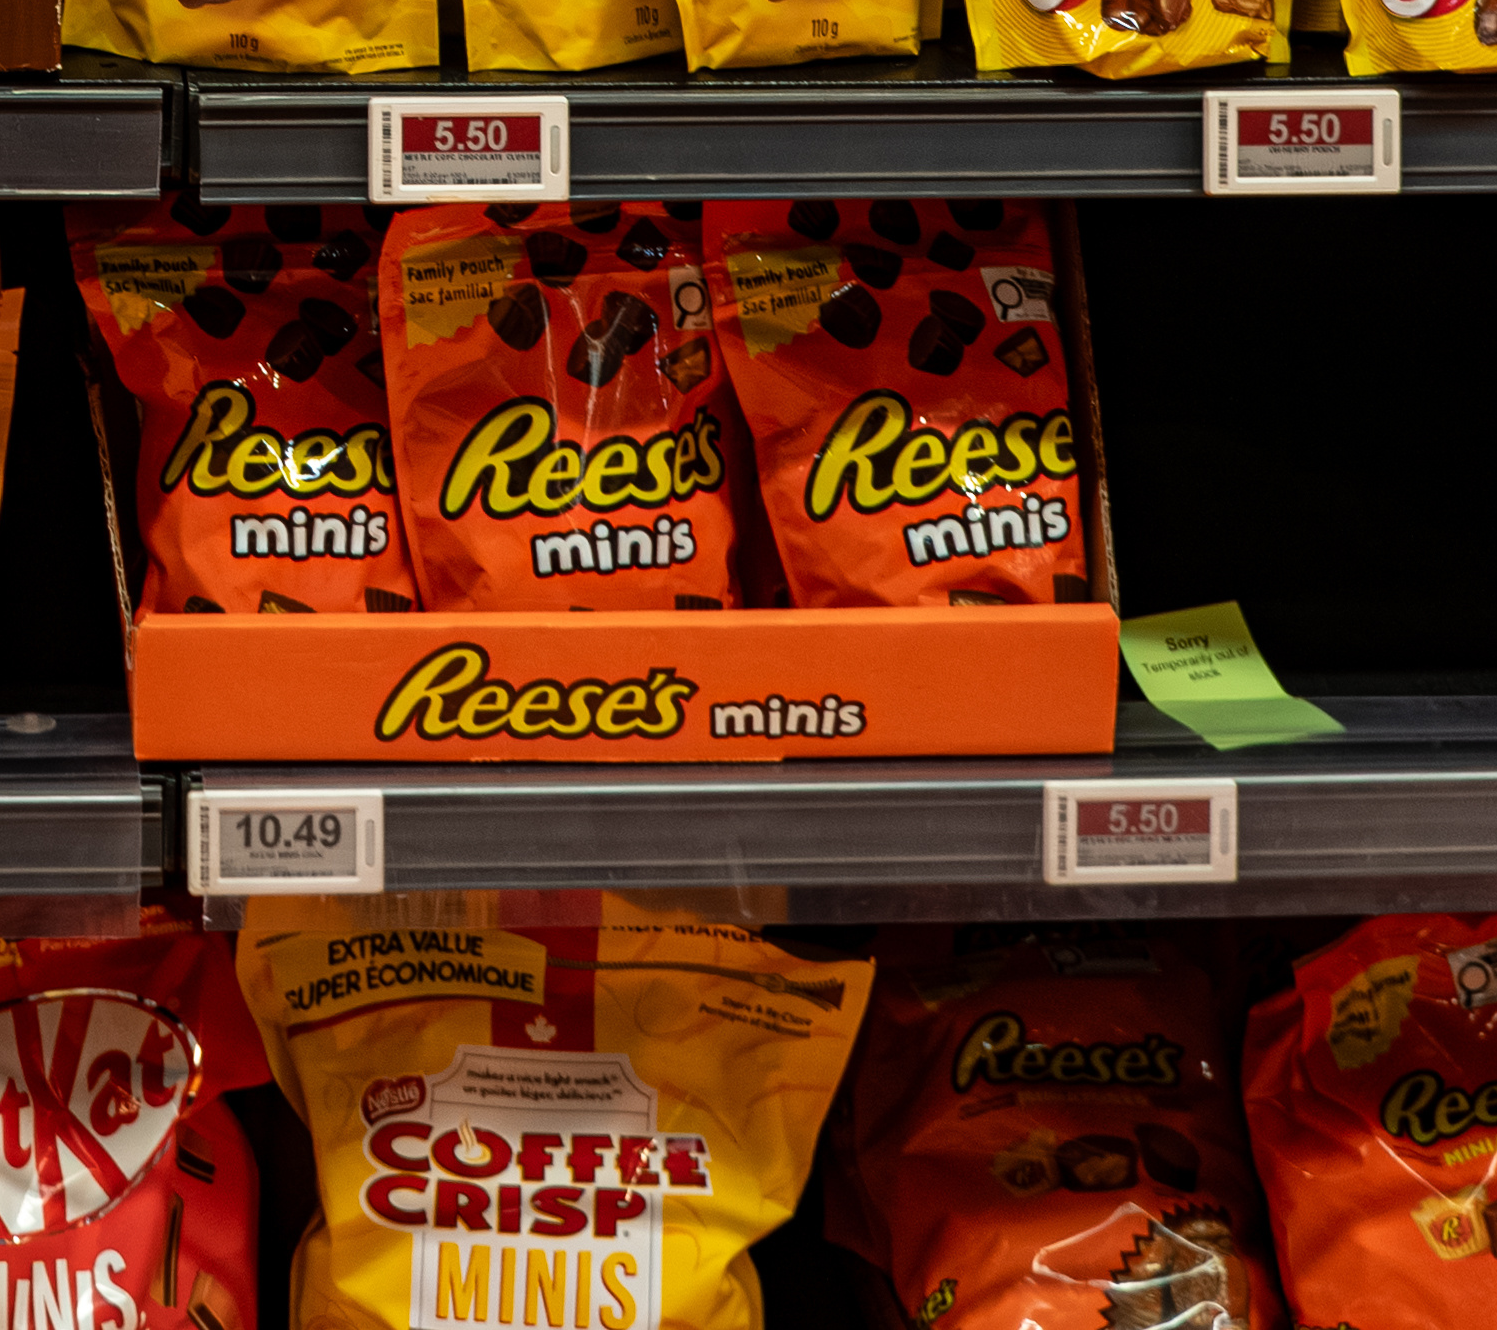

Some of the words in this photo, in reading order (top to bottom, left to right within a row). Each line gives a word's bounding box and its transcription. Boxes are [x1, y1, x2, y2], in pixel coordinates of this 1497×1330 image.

[434, 120, 507, 151] 5.50
[1269, 114, 1341, 144] 5.50
[1165, 635, 1209, 651] Sorry
[379, 646, 692, 738] Reese's
[714, 697, 864, 738] minis
[235, 814, 341, 849] 10.49
[1108, 803, 1178, 833] 5.50
[437, 1243, 638, 1327] MINIS
